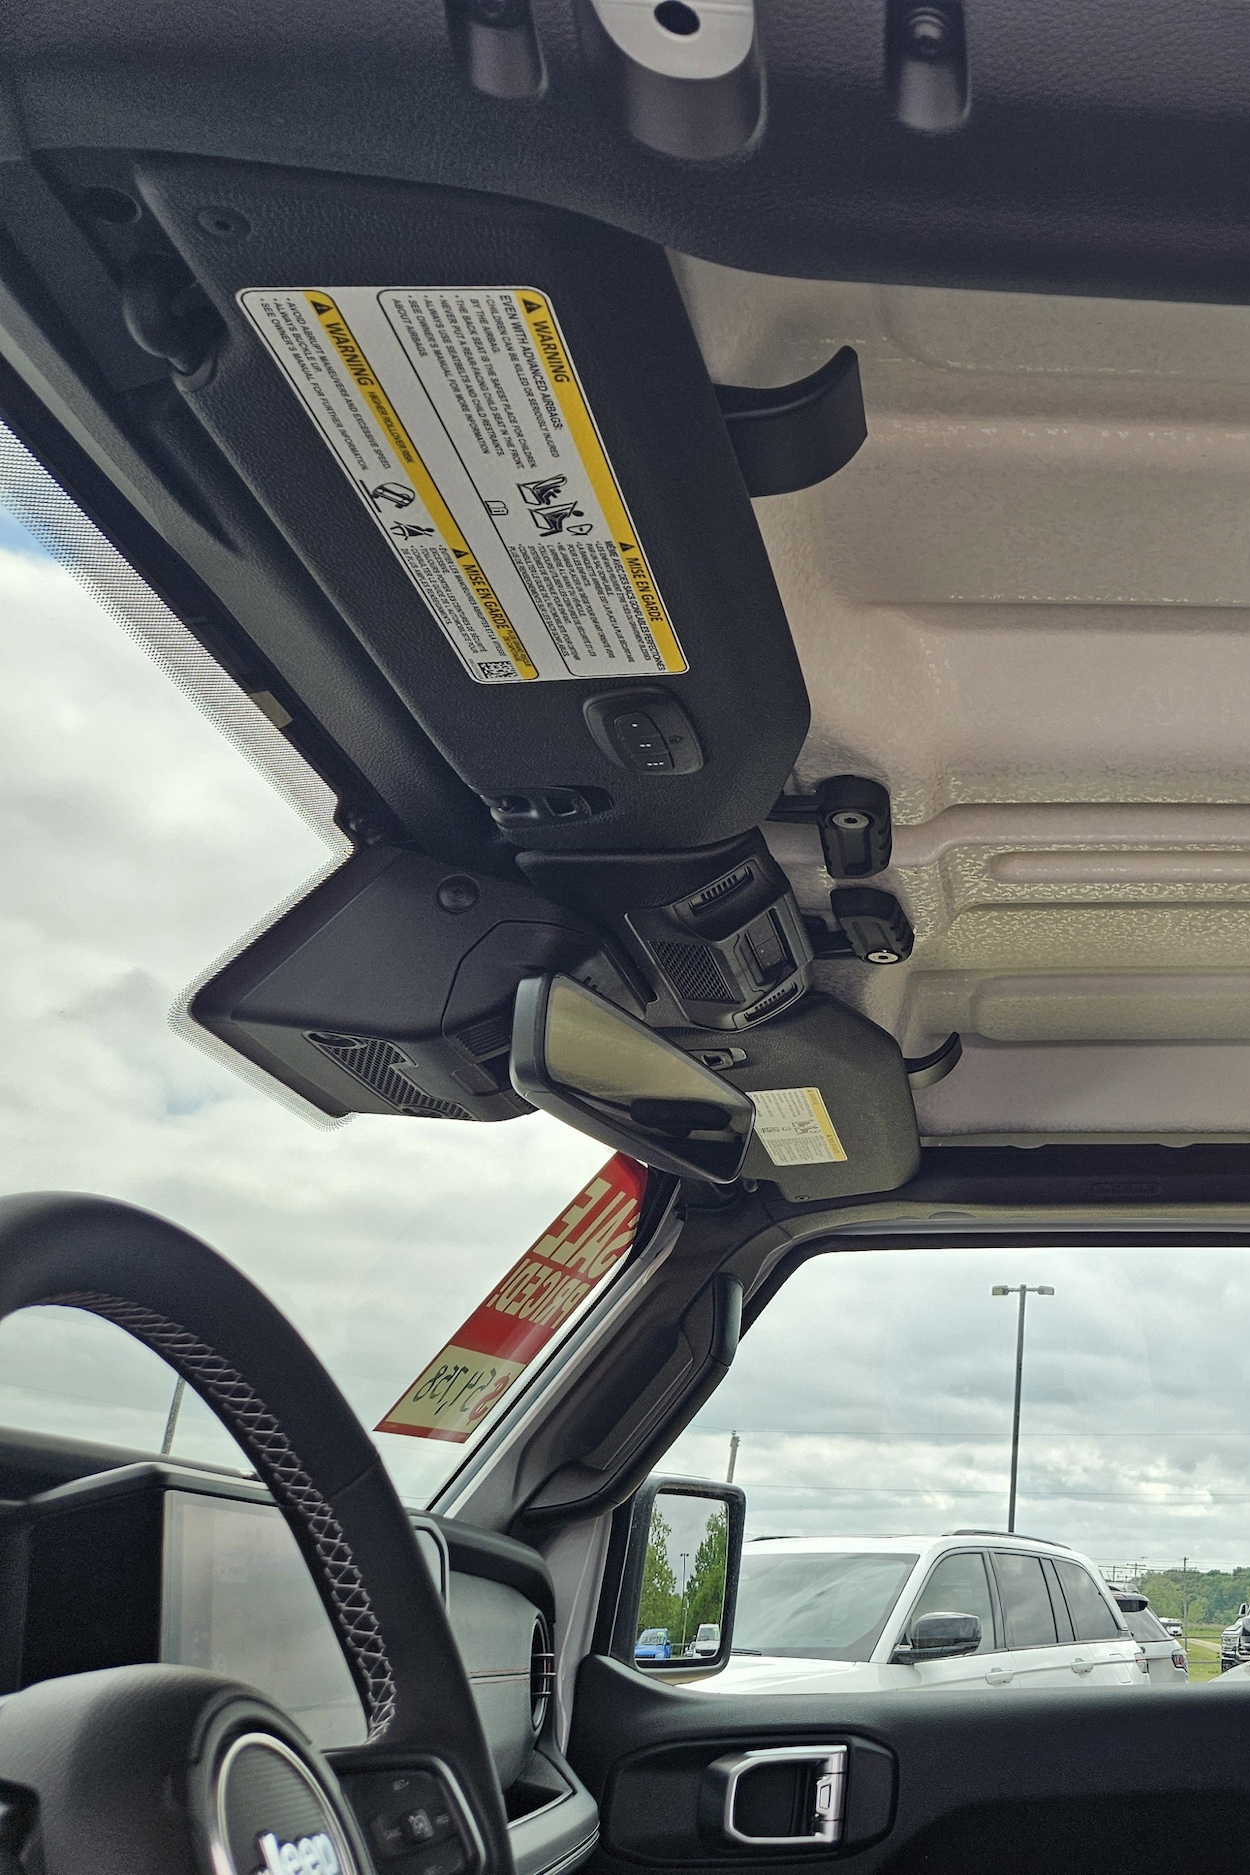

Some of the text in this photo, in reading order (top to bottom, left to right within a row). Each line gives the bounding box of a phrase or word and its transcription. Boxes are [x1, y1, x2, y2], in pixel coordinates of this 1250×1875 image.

[273, 302, 297, 331] ALWAYS
[291, 332, 316, 361] BUCKLE
[391, 298, 412, 323] ABOUT
[455, 299, 468, 313] THE
[461, 315, 478, 335] BACK
[469, 298, 481, 308] BY
[475, 310, 489, 324] THE
[260, 302, 276, 317] SEE
[270, 318, 297, 351] OWNER'S
[292, 352, 314, 380] MANUAL
[310, 382, 325, 396] FOR
[319, 397, 343, 427] FURTHER
[286, 302, 306, 324] AVOID
[300, 325, 324, 353] ABRUPT
[318, 355, 349, 397] MANEUVERS
[343, 397, 358, 412] AND
[352, 413, 379, 447] EXCESSIVE
[325, 322, 374, 385] WARNING
[423, 299, 444, 328] ALWAYS
[438, 329, 452, 343] USE
[445, 345, 470, 383] SEATBELTS
[464, 383, 477, 397] AND
[471, 398, 486, 417] CHILD
[439, 299, 457, 324] NEVER
[451, 325, 465, 338] PUT
[461, 346, 489, 391] REAR-FACING
[482, 392, 498, 411] CHILD
[491, 412, 506, 427] SEAT
[503, 436, 515, 448] THE
[471, 336, 487, 354] SEAT
[484, 363, 497, 376] THE
[499, 294, 563, 430] EVEN WITH ADVANCED AIRBAGS:
[532, 320, 570, 382] WARNING
[407, 299, 490, 454] SEE OWNER'S MANUAL FOR MORE INFORMATION
[485, 298, 559, 457] CHILDREN CAN BE KILLED OR SERIOUSLY INJURED
[490, 377, 508, 402] SAFEST
[367, 391, 415, 463] HIGHER ROLLOVER RISK
[502, 403, 518, 423] PLACE
[511, 424, 524, 437] FOR
[461, 564, 486, 585] MISE
[483, 601, 510, 629] GARDE
[625, 557, 646, 578] MISE
[640, 593, 663, 621] GARDE
[256, 1833, 339, 1875] Jeep
